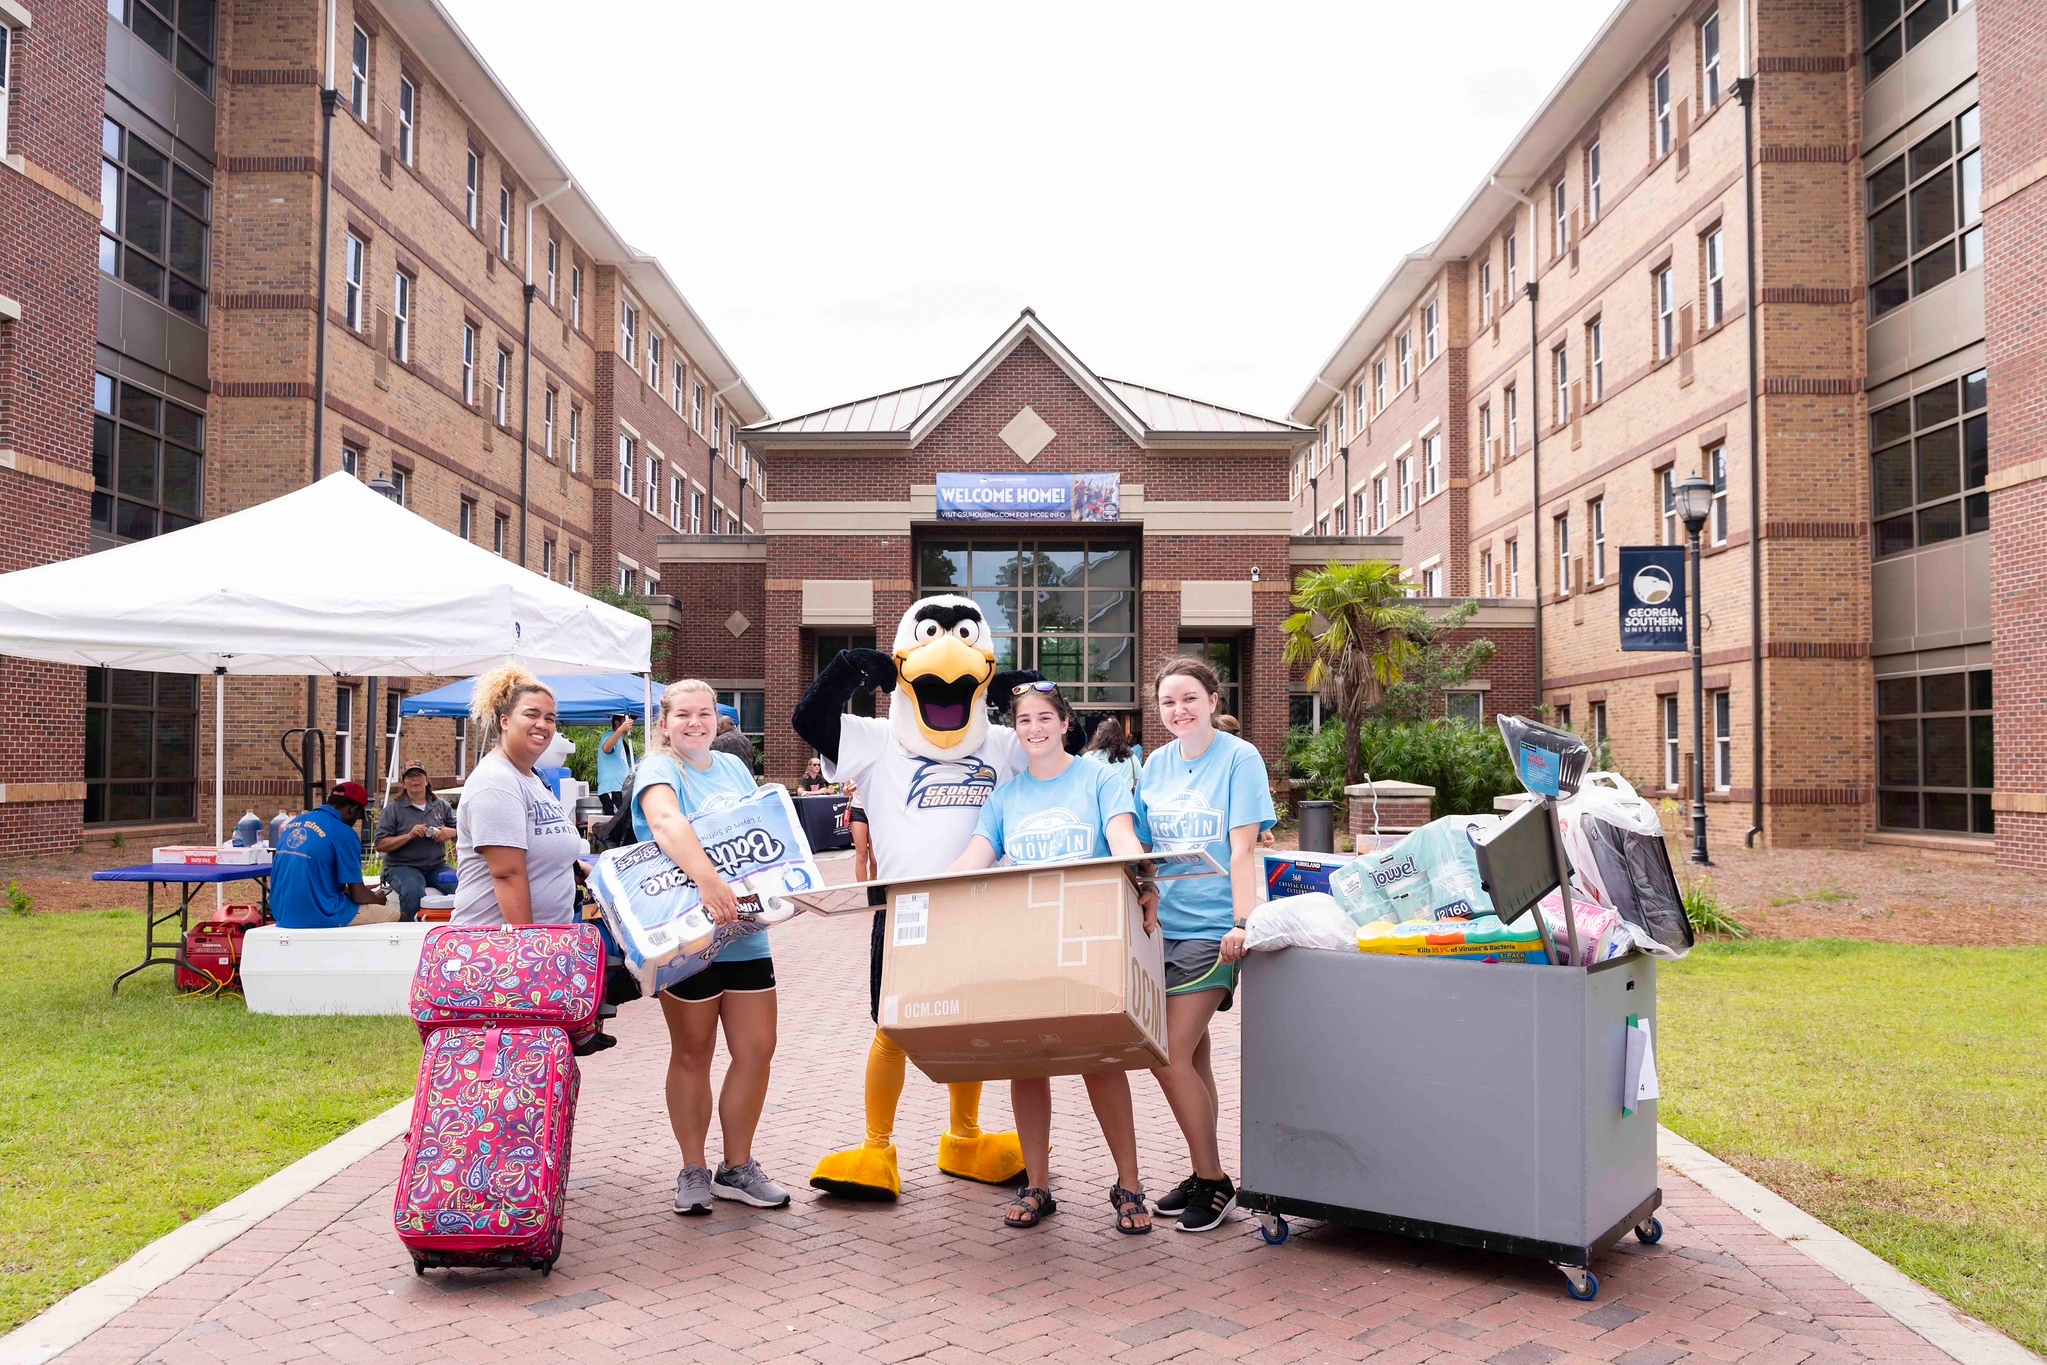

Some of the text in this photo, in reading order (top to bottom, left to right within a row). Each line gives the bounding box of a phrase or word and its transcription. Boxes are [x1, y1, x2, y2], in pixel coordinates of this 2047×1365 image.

[941, 487, 1066, 503] WELCOME HOME!
[1628, 607, 1679, 618] GEORGIA
[1624, 617, 1683, 627] SOUTHERN
[926, 785, 994, 796] GEORGIA
[920, 795, 989, 808] SOUTHERN
[725, 825, 733, 833] of
[733, 818, 755, 829] Layers
[1150, 819, 1213, 837] MOVE-IN
[1024, 829, 1070, 842] OPERATION
[704, 828, 785, 877] Bath
[1011, 834, 1084, 860] MOVE-IN
[1295, 861, 1321, 869] KIRKLAND
[1368, 854, 1418, 889] Towel
[1291, 873, 1302, 882] 360
[1278, 881, 1316, 891] CRYSTAL CLEAR
[1286, 887, 1308, 895] CUTLERY
[911, 894, 917, 902] H
[1448, 902, 1469, 918] 160
[1489, 943, 1516, 951] Bacteria
[1131, 956, 1162, 1045] OCM
[904, 999, 960, 1019] OCM.COM
[1640, 1083, 1645, 1092] 4
